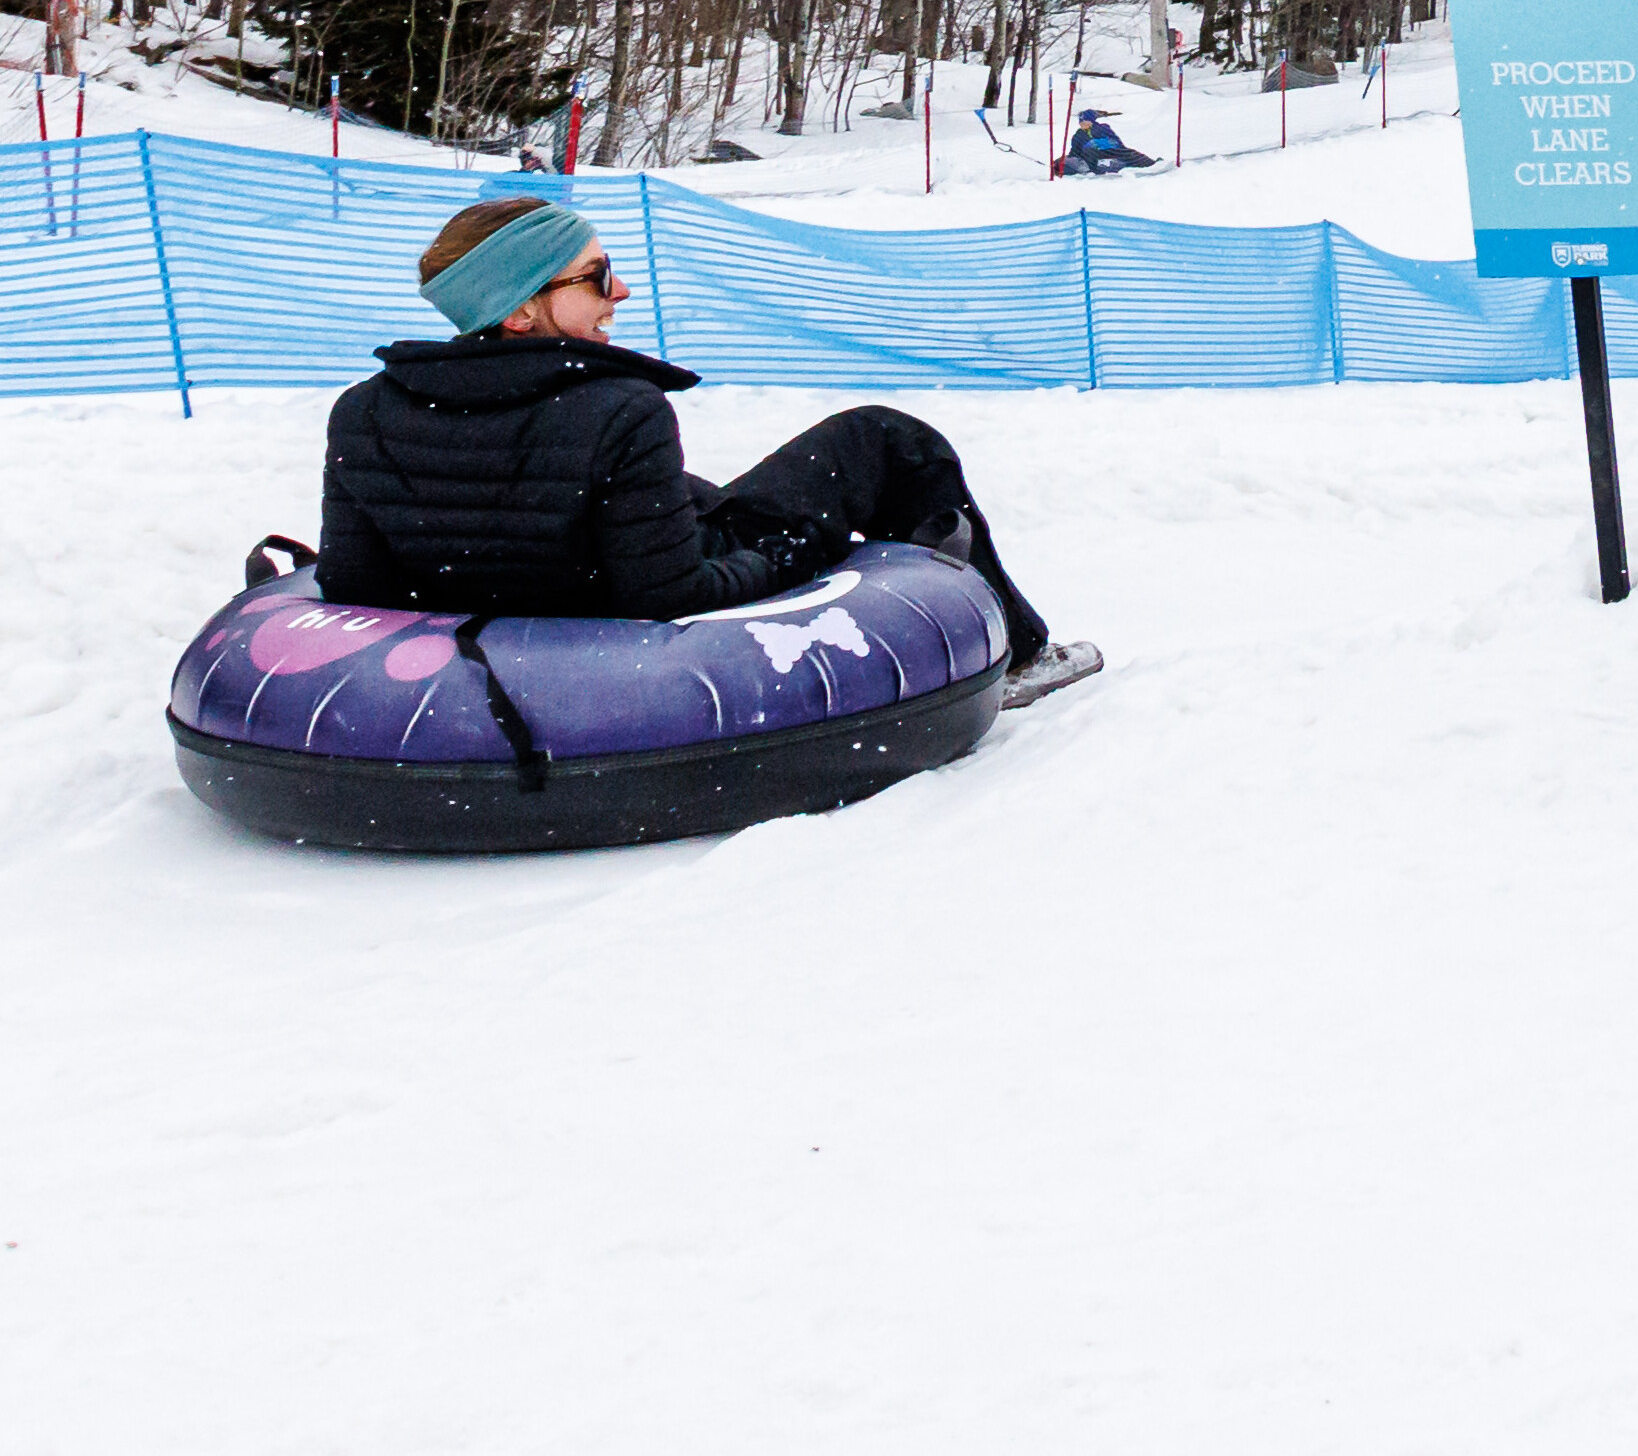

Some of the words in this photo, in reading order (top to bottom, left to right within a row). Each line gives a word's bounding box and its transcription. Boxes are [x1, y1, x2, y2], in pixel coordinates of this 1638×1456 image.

[1490, 60, 1636, 85] PROCEED
[1519, 94, 1611, 119] WHEN
[1531, 128, 1610, 152] LANE
[1514, 160, 1632, 185] CLEARS
[286, 609, 351, 629] hi
[341, 616, 382, 631] u
